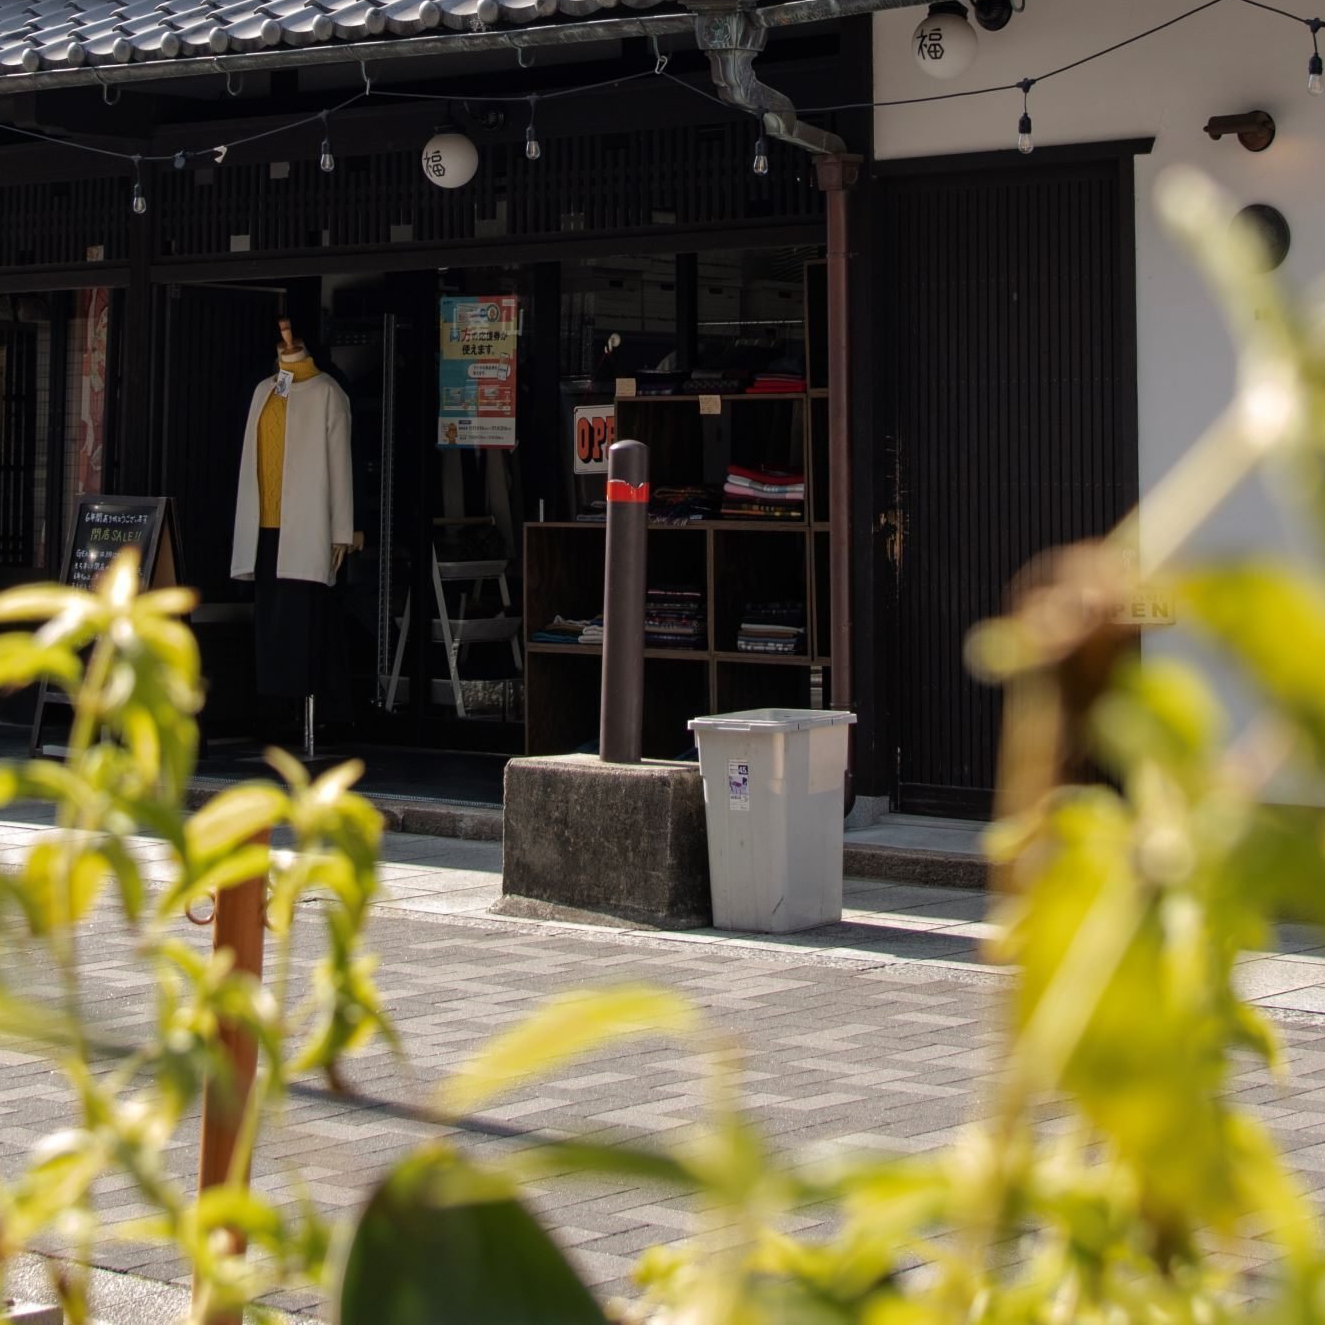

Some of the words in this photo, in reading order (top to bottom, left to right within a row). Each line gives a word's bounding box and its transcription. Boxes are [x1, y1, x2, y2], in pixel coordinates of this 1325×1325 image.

[917, 27, 945, 60] 福
[423, 150, 446, 178] 福
[577, 416, 616, 464] OPE
[1111, 602, 1169, 618] PEN
